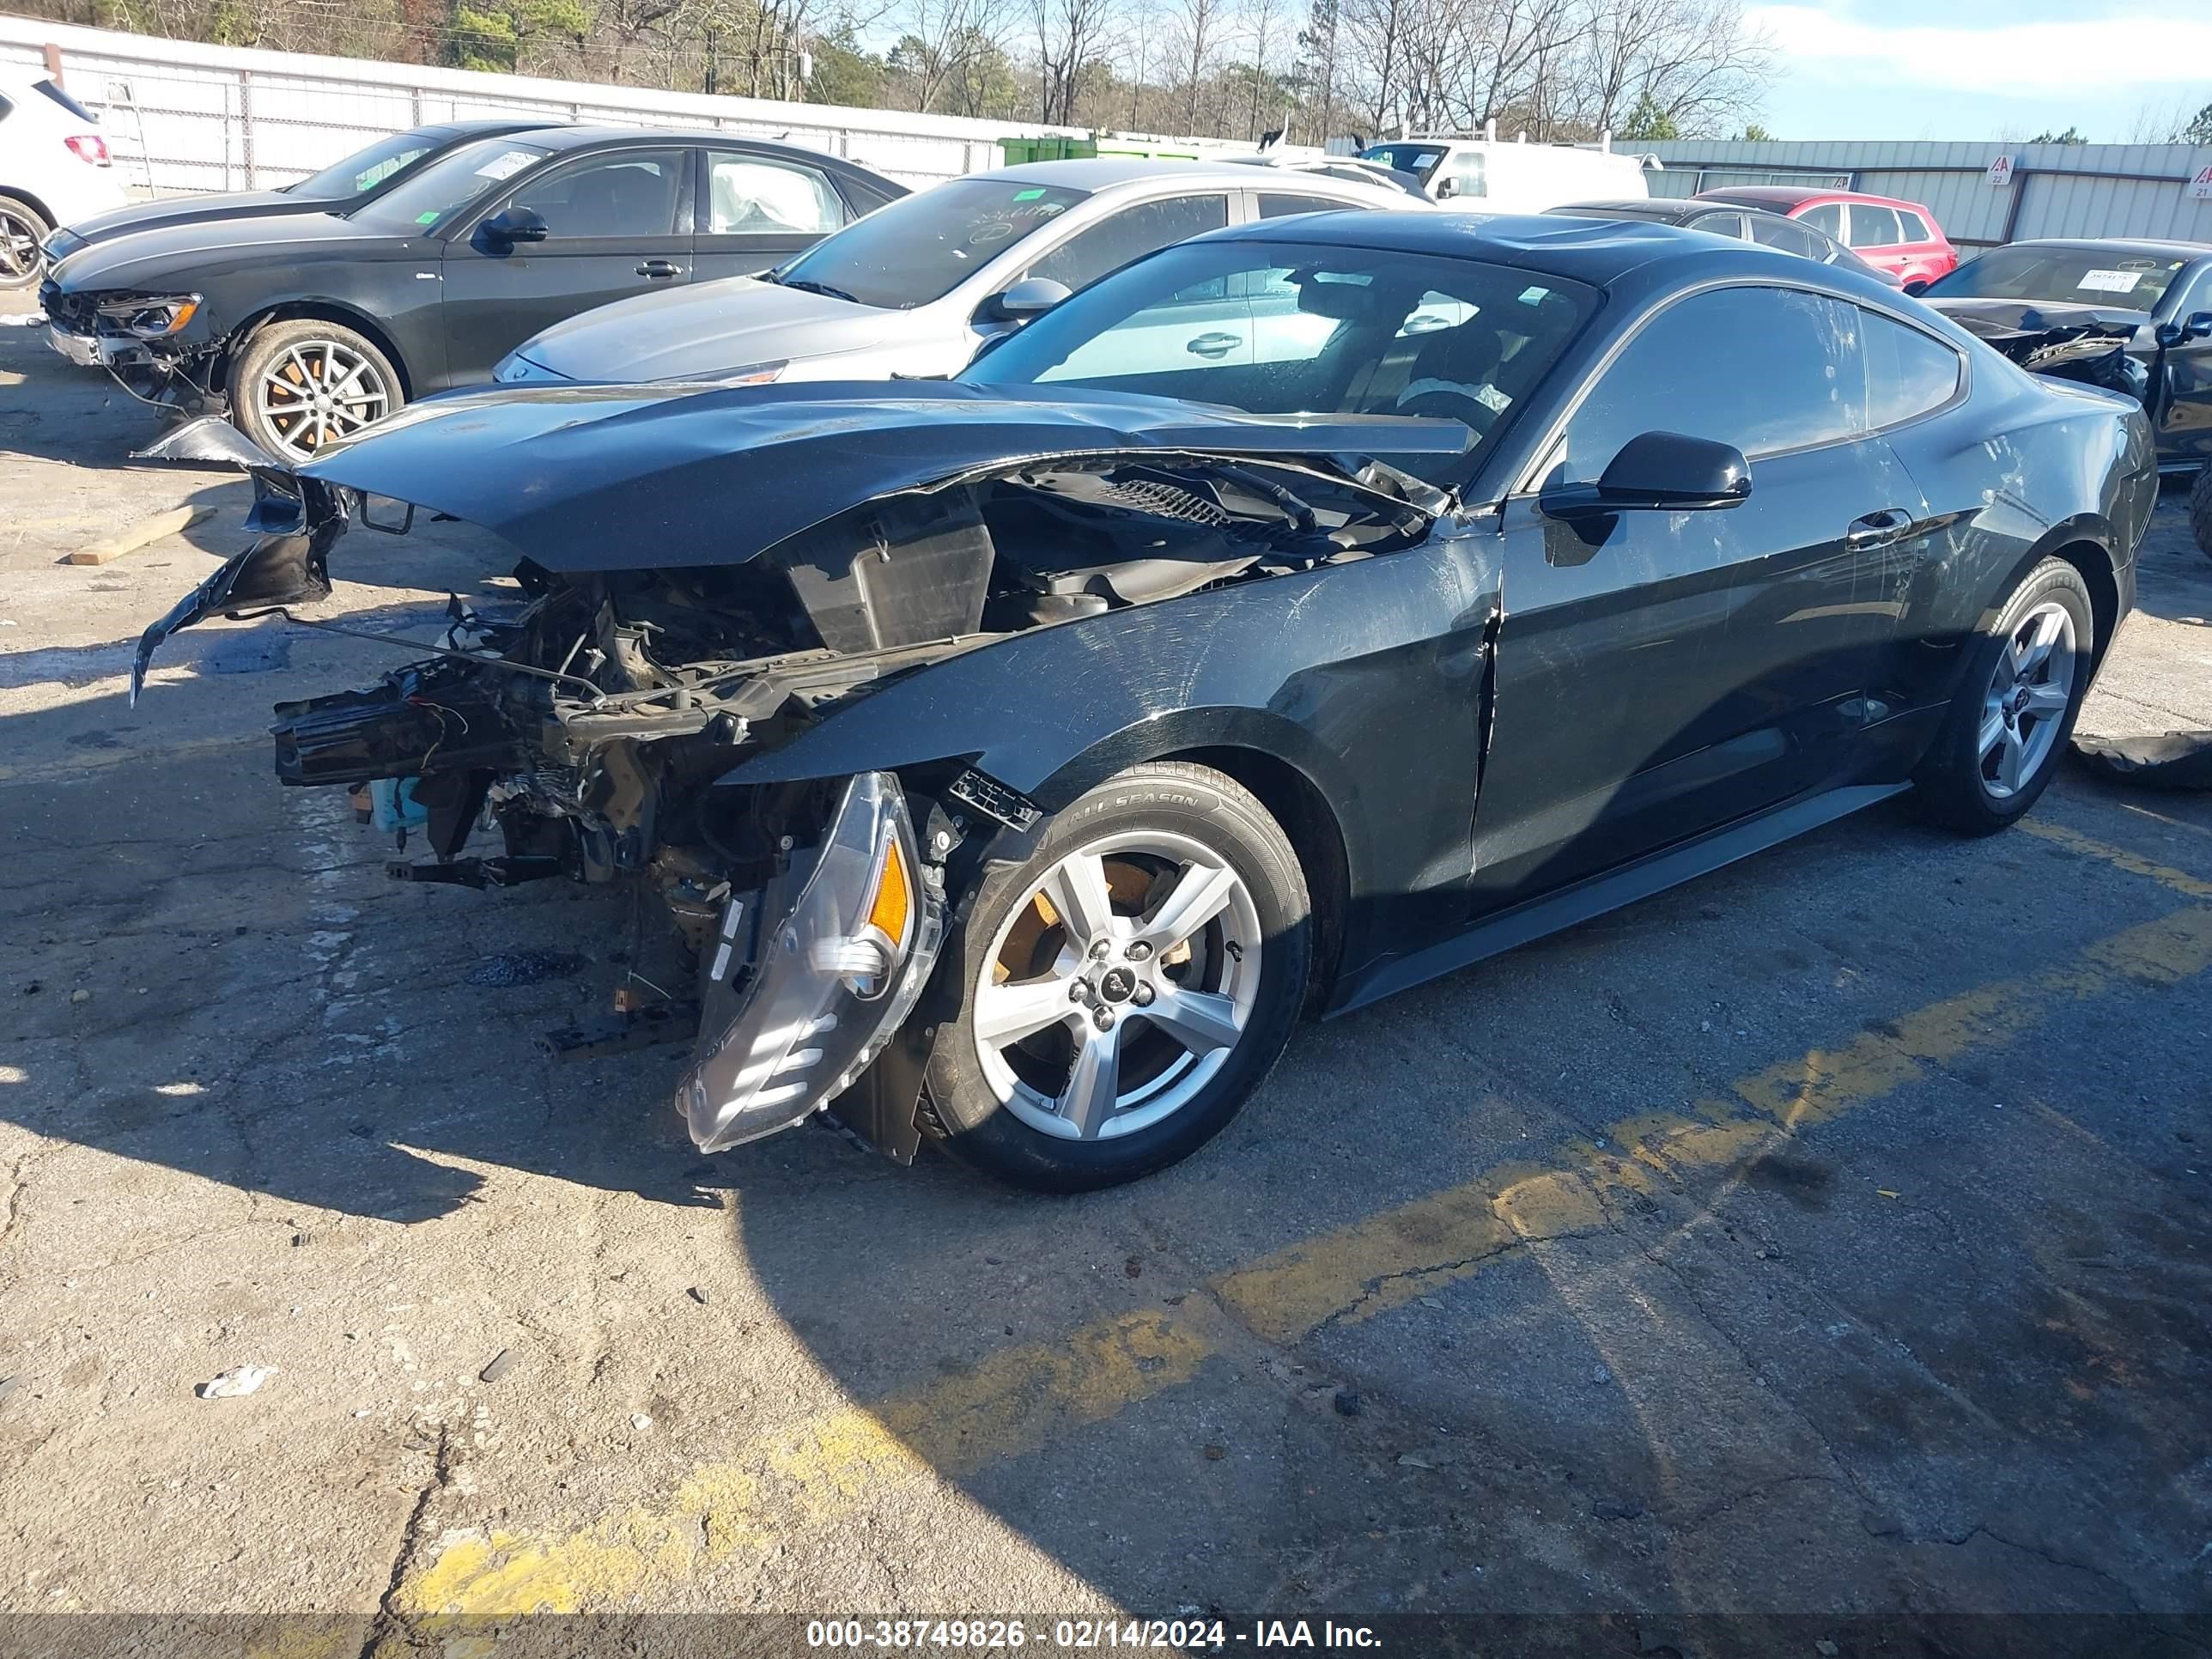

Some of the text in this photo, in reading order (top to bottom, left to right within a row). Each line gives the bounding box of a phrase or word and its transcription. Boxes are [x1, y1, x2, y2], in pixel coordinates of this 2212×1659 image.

[1992, 175, 2002, 184] 22
[2196, 188, 2208, 197] 21
[1066, 793, 1199, 827] ALL SEASON
